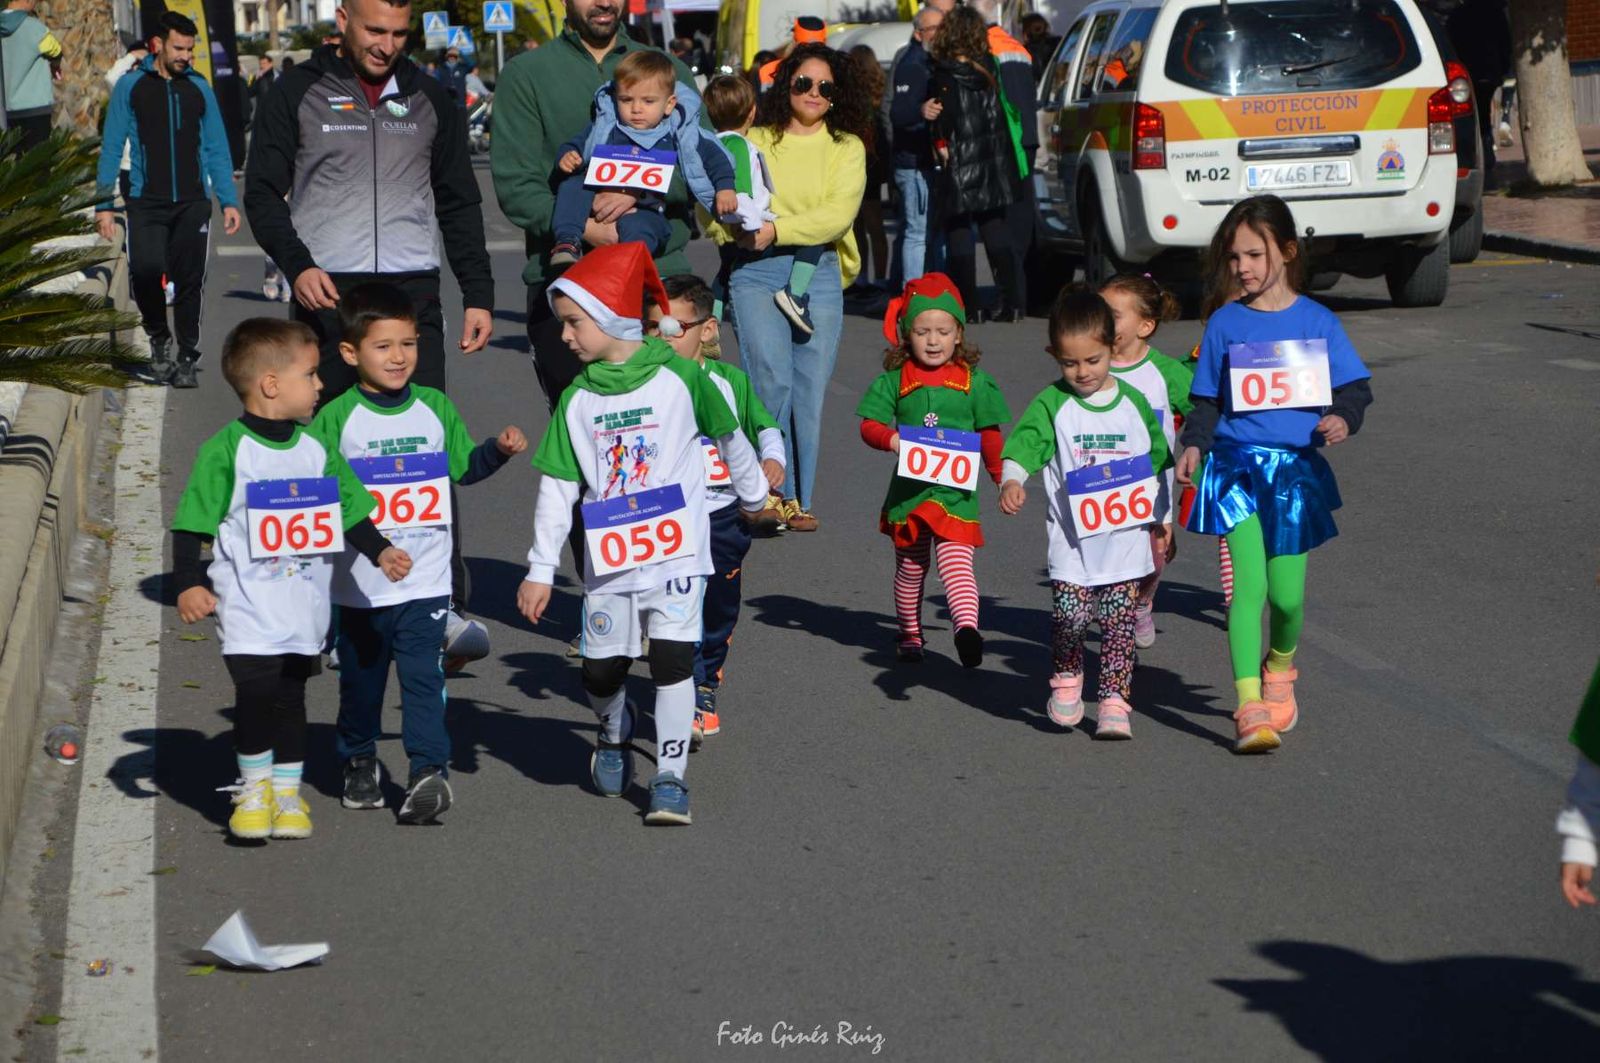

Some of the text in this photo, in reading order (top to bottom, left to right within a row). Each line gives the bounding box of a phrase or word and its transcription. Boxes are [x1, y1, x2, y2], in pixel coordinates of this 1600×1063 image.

[1241, 93, 1359, 115] PROTECCIÓN
[1275, 116, 1326, 132] CIVIL
[595, 162, 663, 187] 076
[1185, 167, 1230, 183] M-02
[907, 446, 971, 485] 070
[368, 485, 442, 525] 062
[1079, 485, 1152, 531] 066
[259, 511, 334, 552] 065
[600, 518, 683, 568] 059
